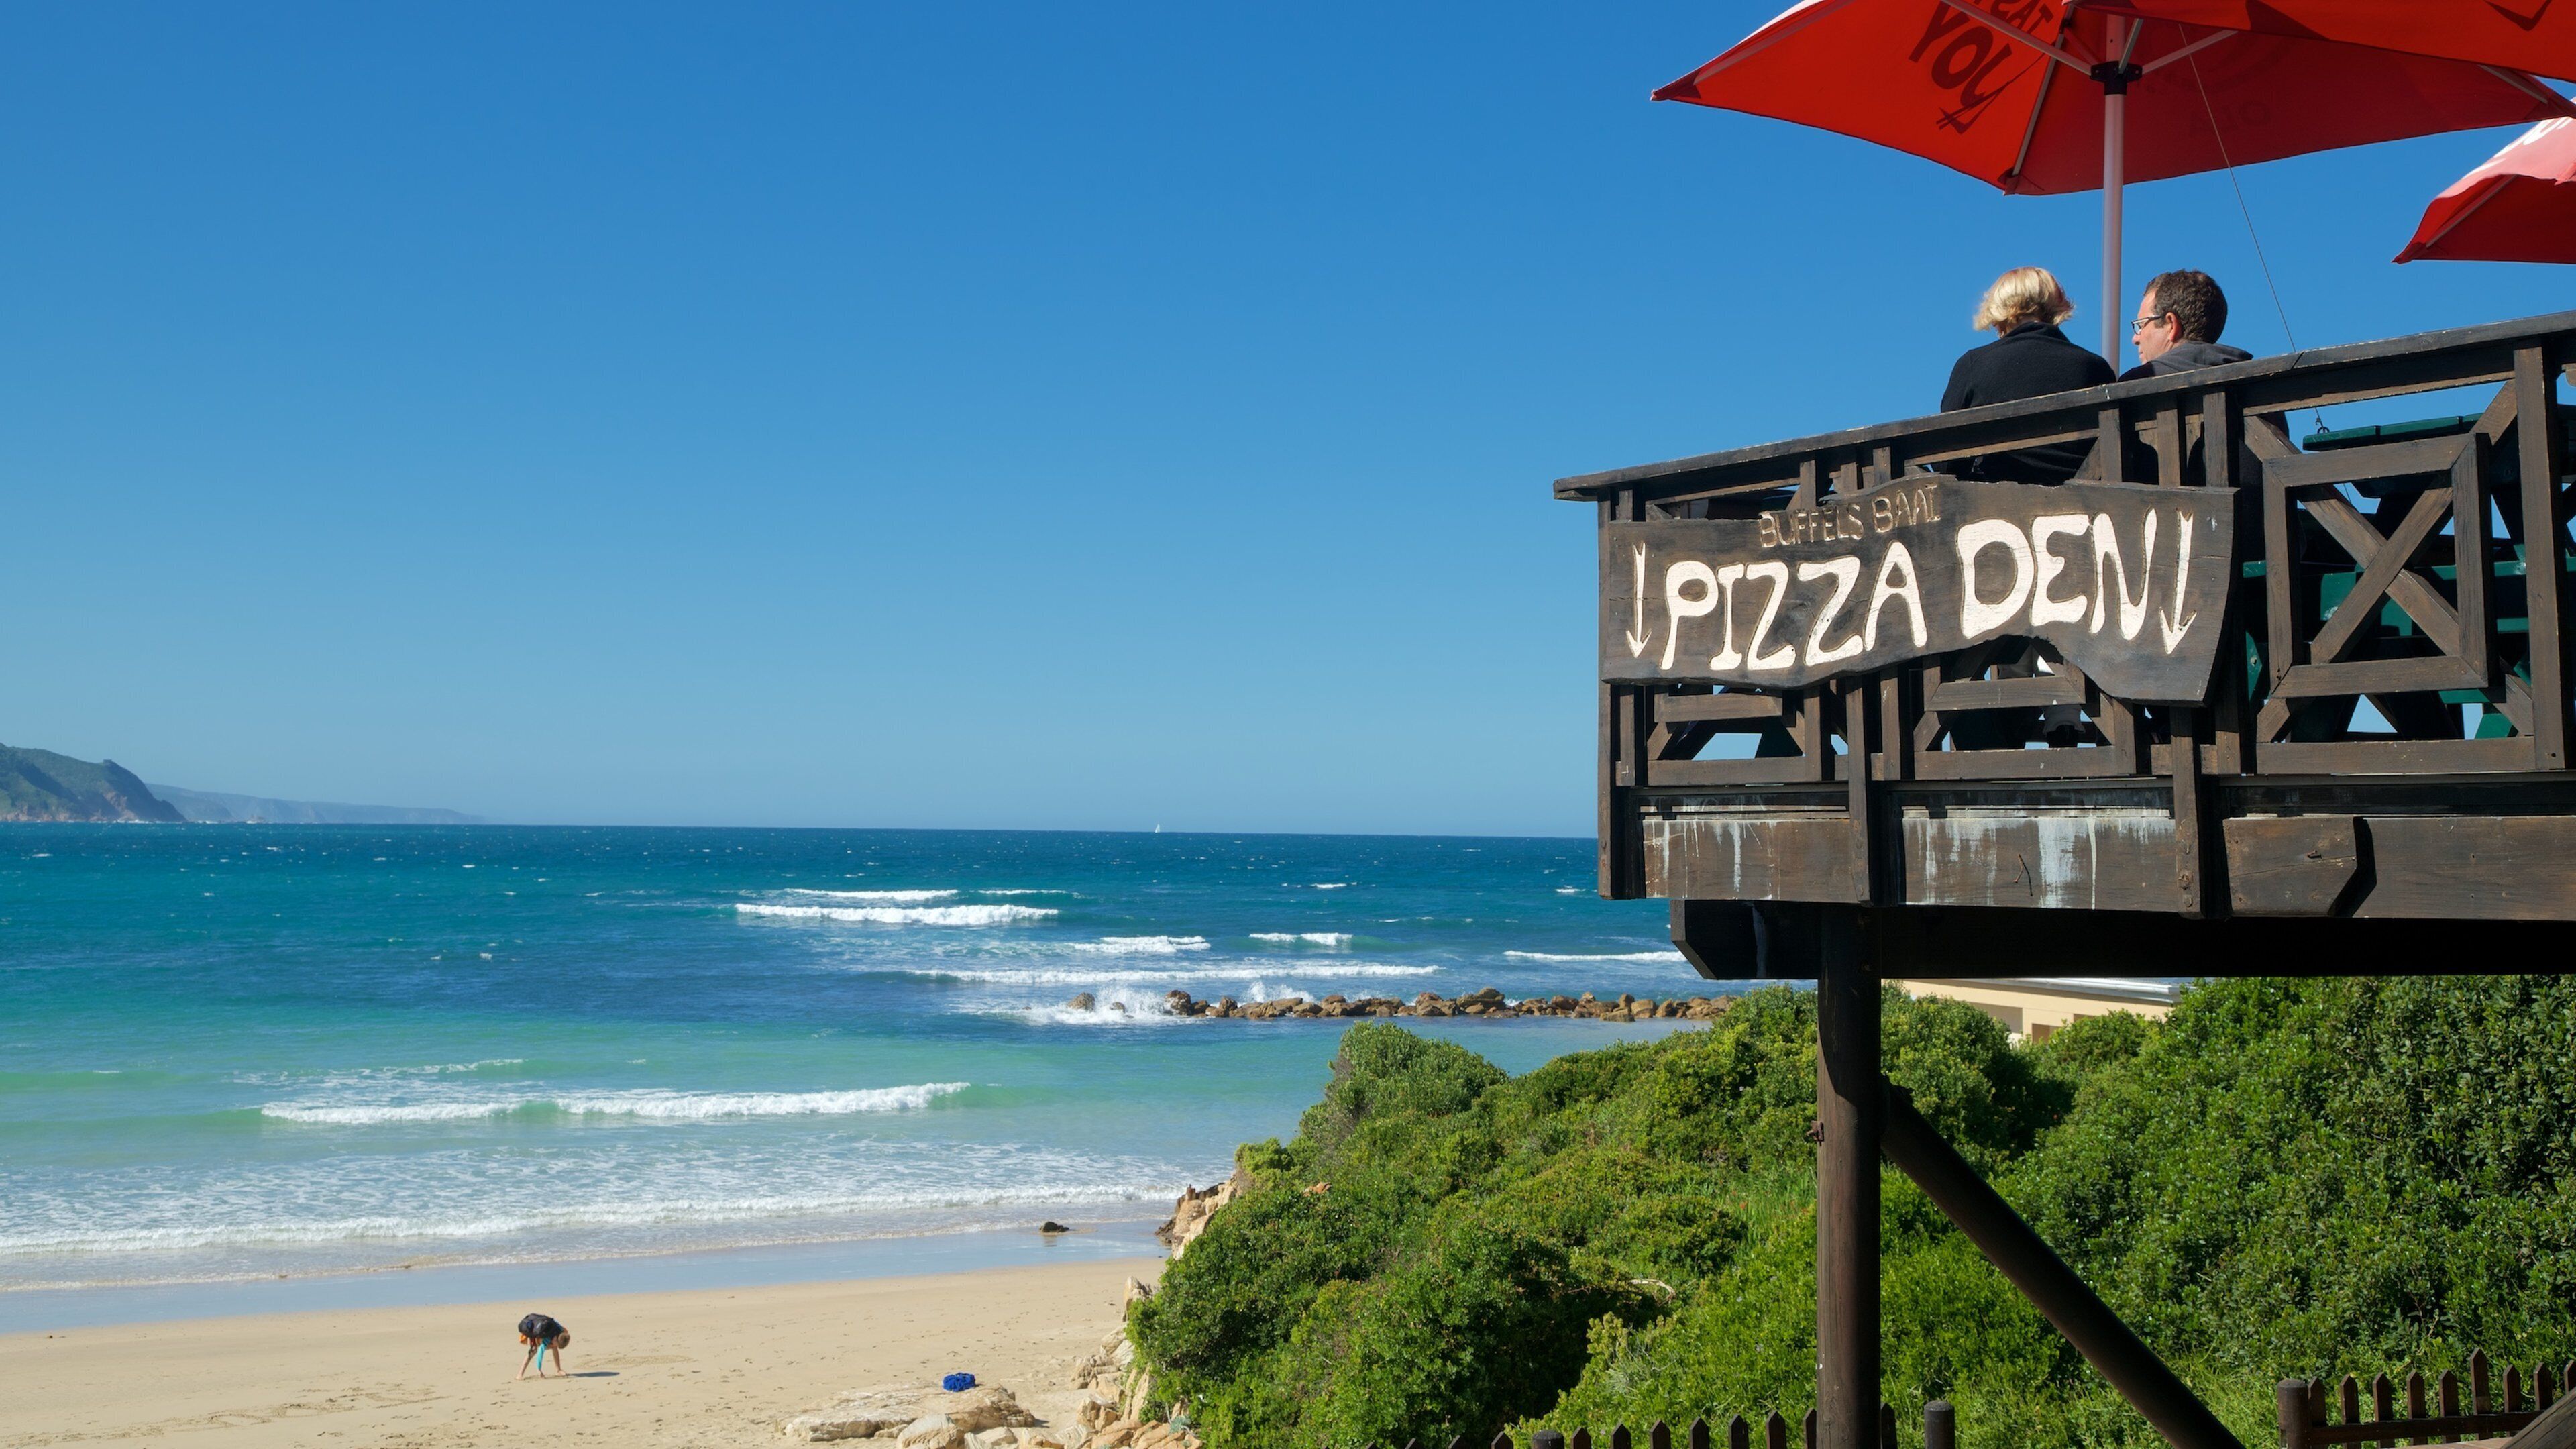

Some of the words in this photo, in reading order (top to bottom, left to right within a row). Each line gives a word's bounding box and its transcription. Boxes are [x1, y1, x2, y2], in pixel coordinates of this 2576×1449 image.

[1909, 1, 2012, 109] YOU
[1758, 504, 1864, 548] BUFFELS
[1660, 540, 1927, 671] PIZZA
[1956, 508, 2158, 641] DEN
